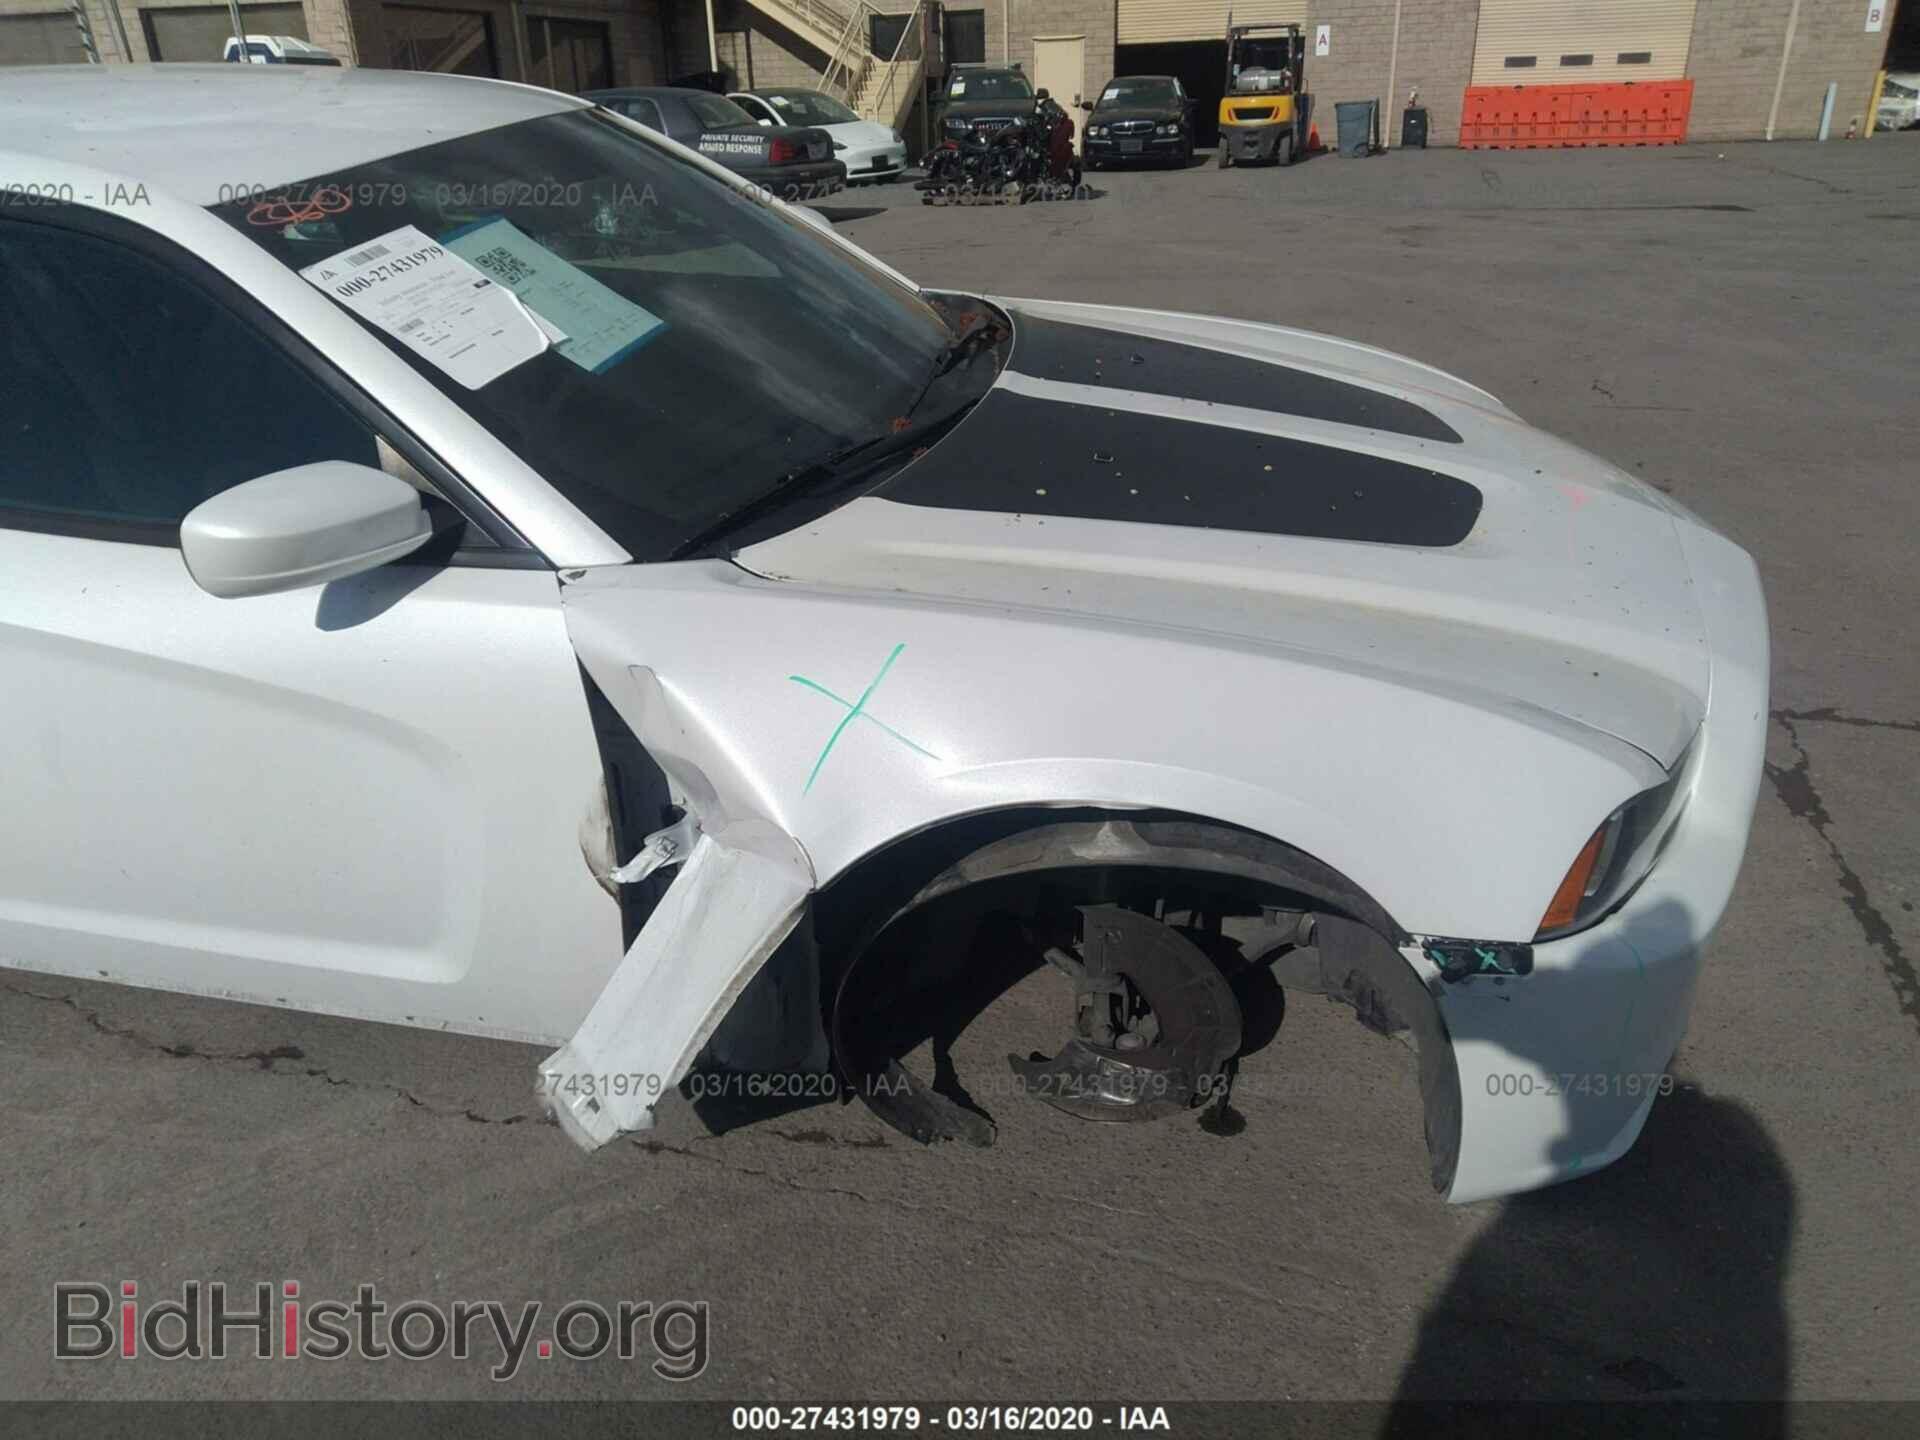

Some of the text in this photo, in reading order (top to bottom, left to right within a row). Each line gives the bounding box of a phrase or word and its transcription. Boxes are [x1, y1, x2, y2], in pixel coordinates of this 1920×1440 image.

[1870, 8, 1881, 23] B
[1318, 32, 1328, 47] A
[700, 133, 766, 143] PRIVATE SECURITY
[726, 143, 762, 154] RESPONSE
[335, 245, 444, 298] 000-27431979
